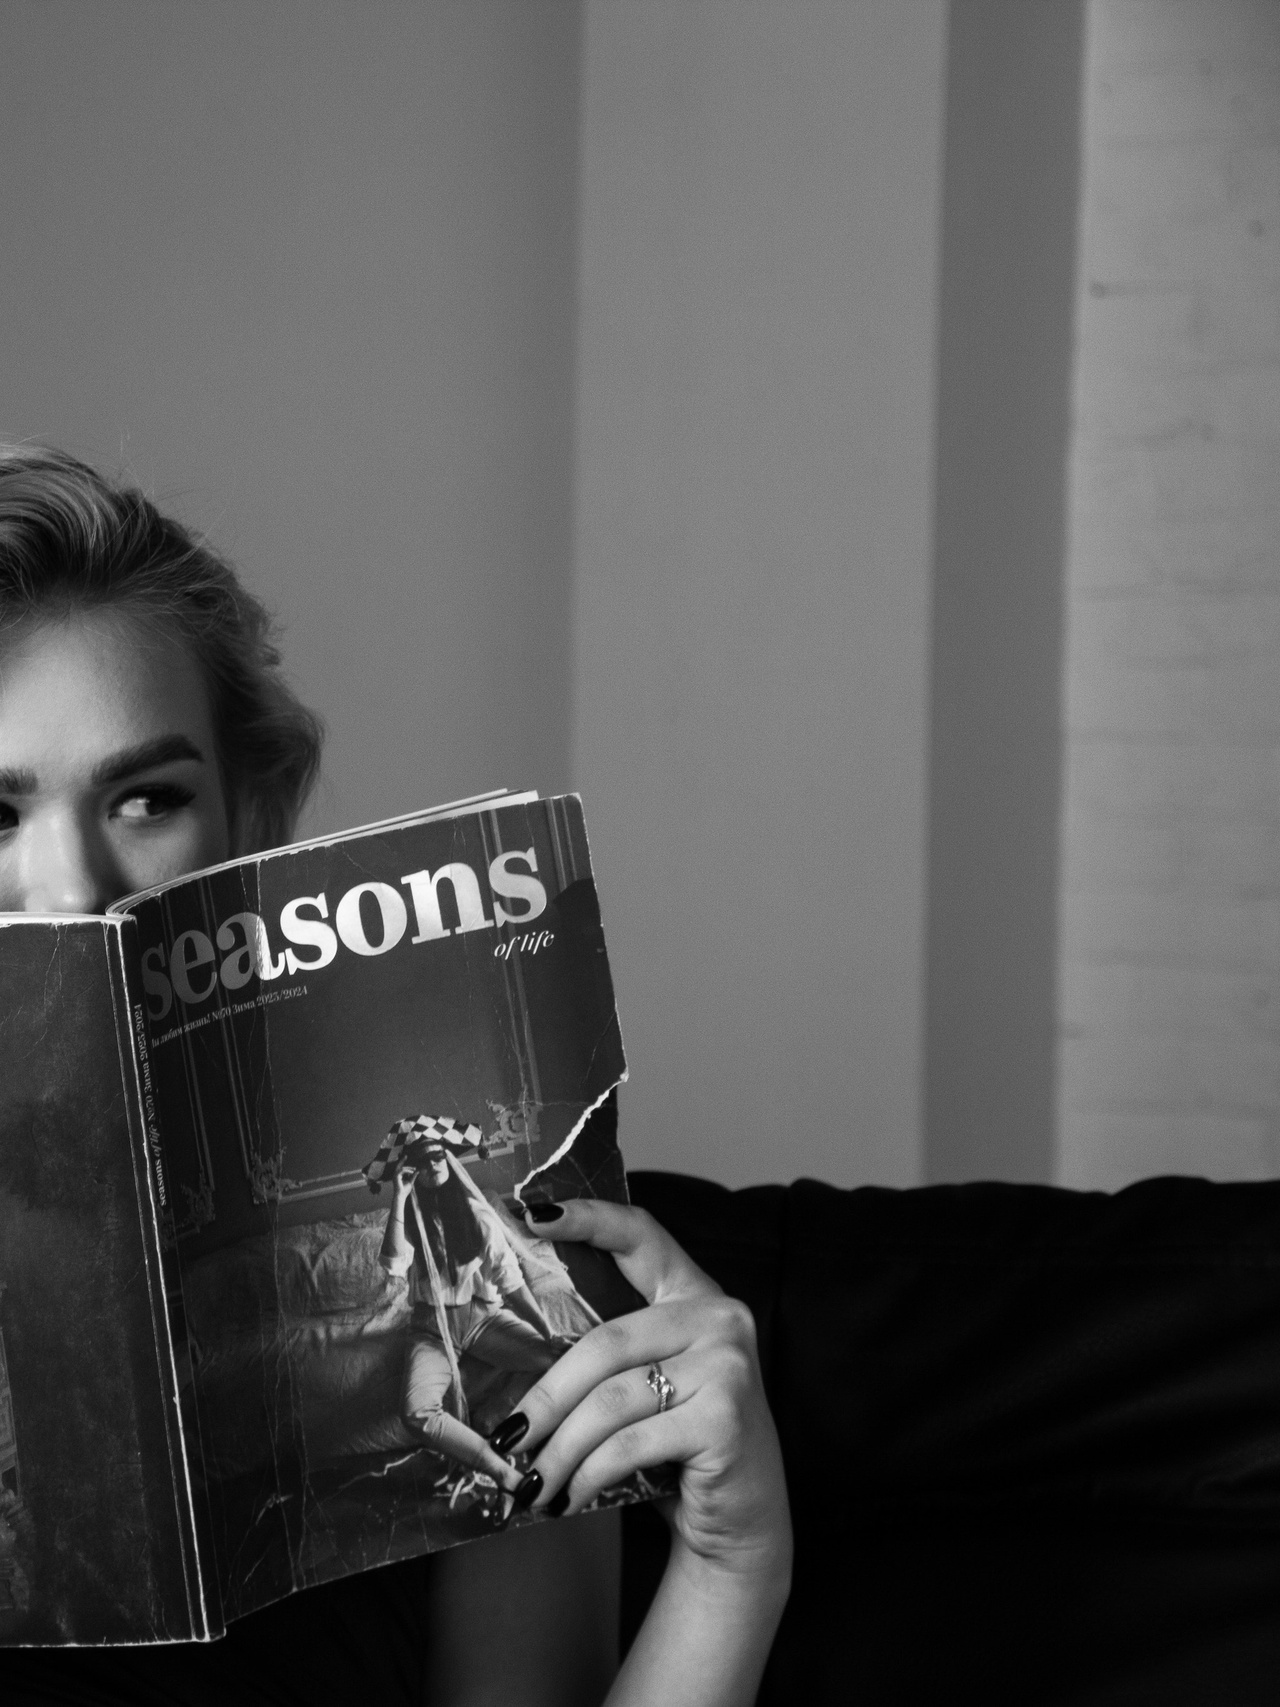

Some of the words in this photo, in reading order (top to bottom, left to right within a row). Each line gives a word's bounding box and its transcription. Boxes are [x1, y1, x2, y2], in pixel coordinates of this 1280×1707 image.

[140, 846, 547, 1022] seasons
[493, 936, 521, 961] of
[520, 929, 555, 956] life
[232, 1001, 256, 1015] Зима
[256, 985, 309, 1006] 2023/2024
[133, 1003, 149, 1061] 2023/2024
[142, 1061, 153, 1094] Зима
[148, 1123, 161, 1143] life
[149, 1141, 162, 1158] of
[154, 1158, 167, 1207] seasons
